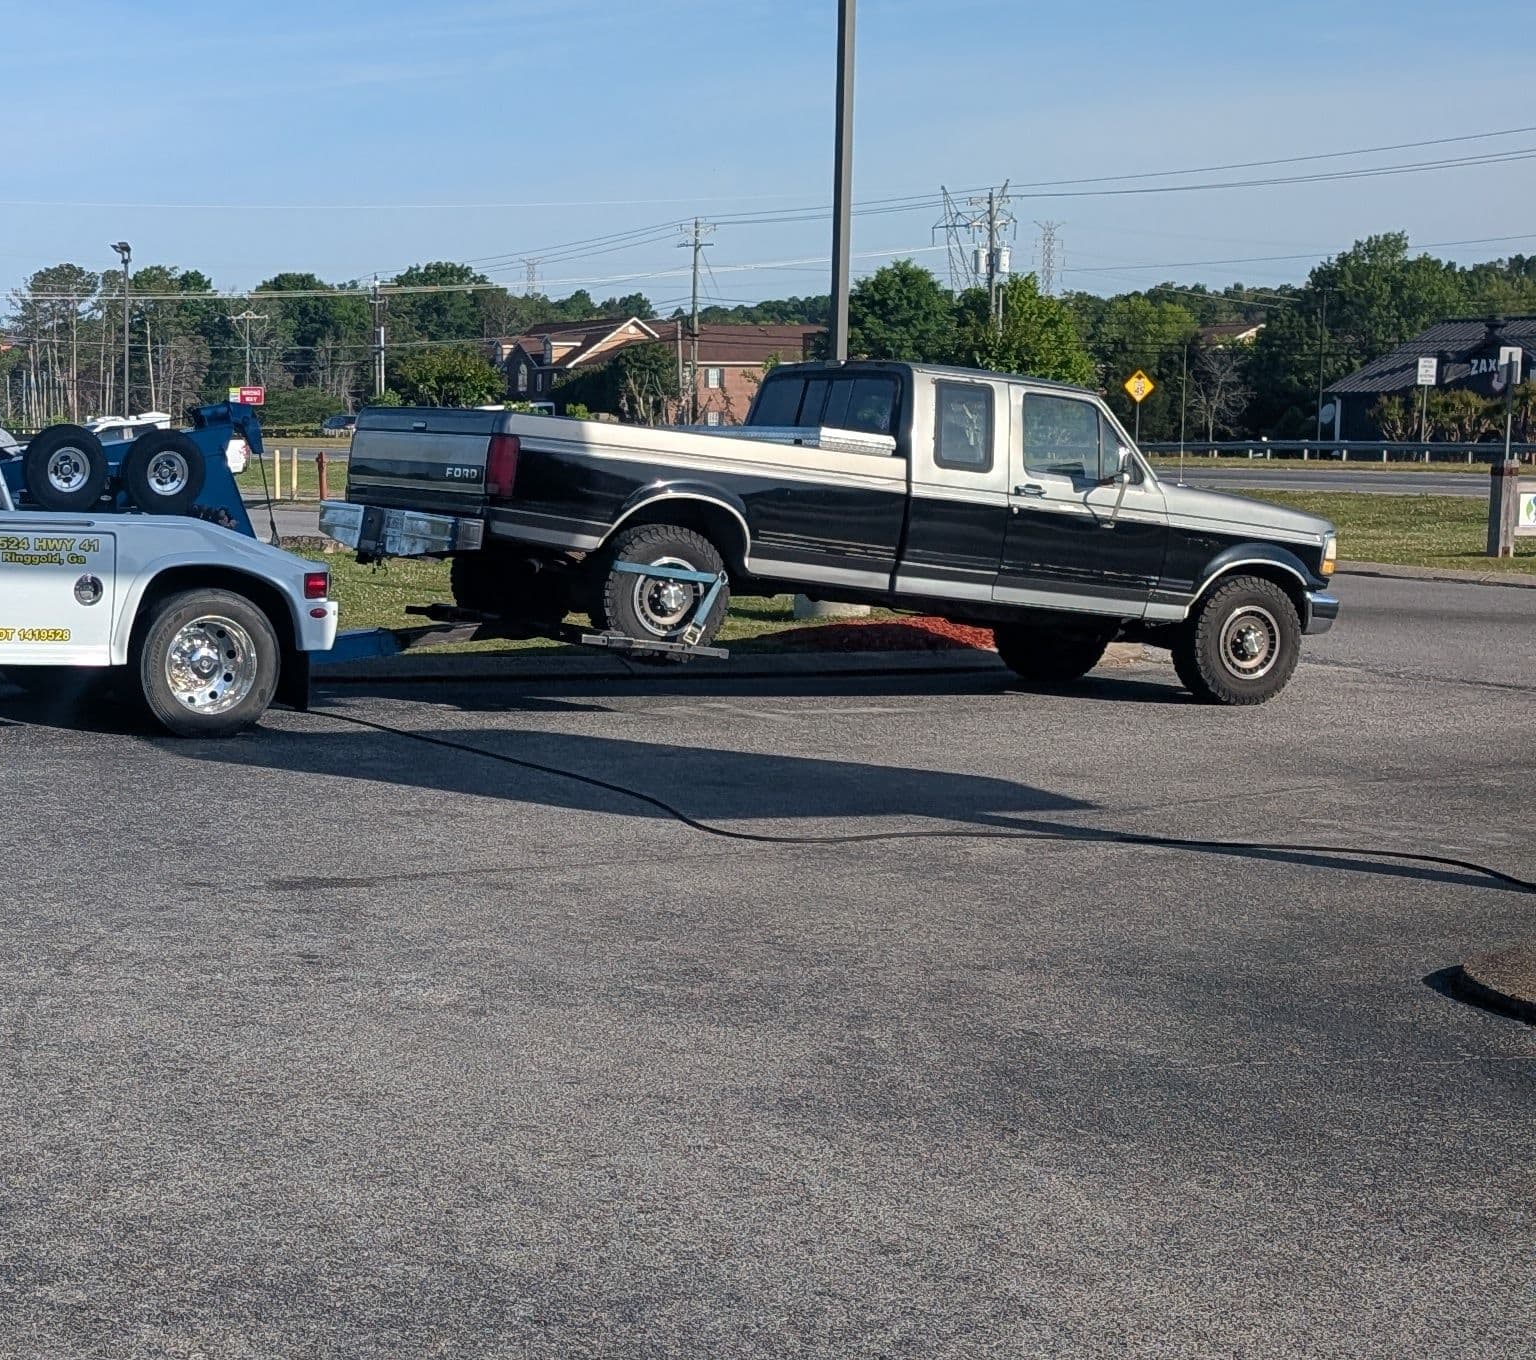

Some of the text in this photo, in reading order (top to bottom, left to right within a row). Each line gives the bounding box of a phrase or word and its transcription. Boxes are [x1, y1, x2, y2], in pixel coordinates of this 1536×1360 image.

[445, 467, 478, 479] FORD
[34, 537, 75, 551] HWY
[79, 538, 100, 552] 41
[67, 553, 86, 564] Ga
[18, 628, 71, 641] 1419528
